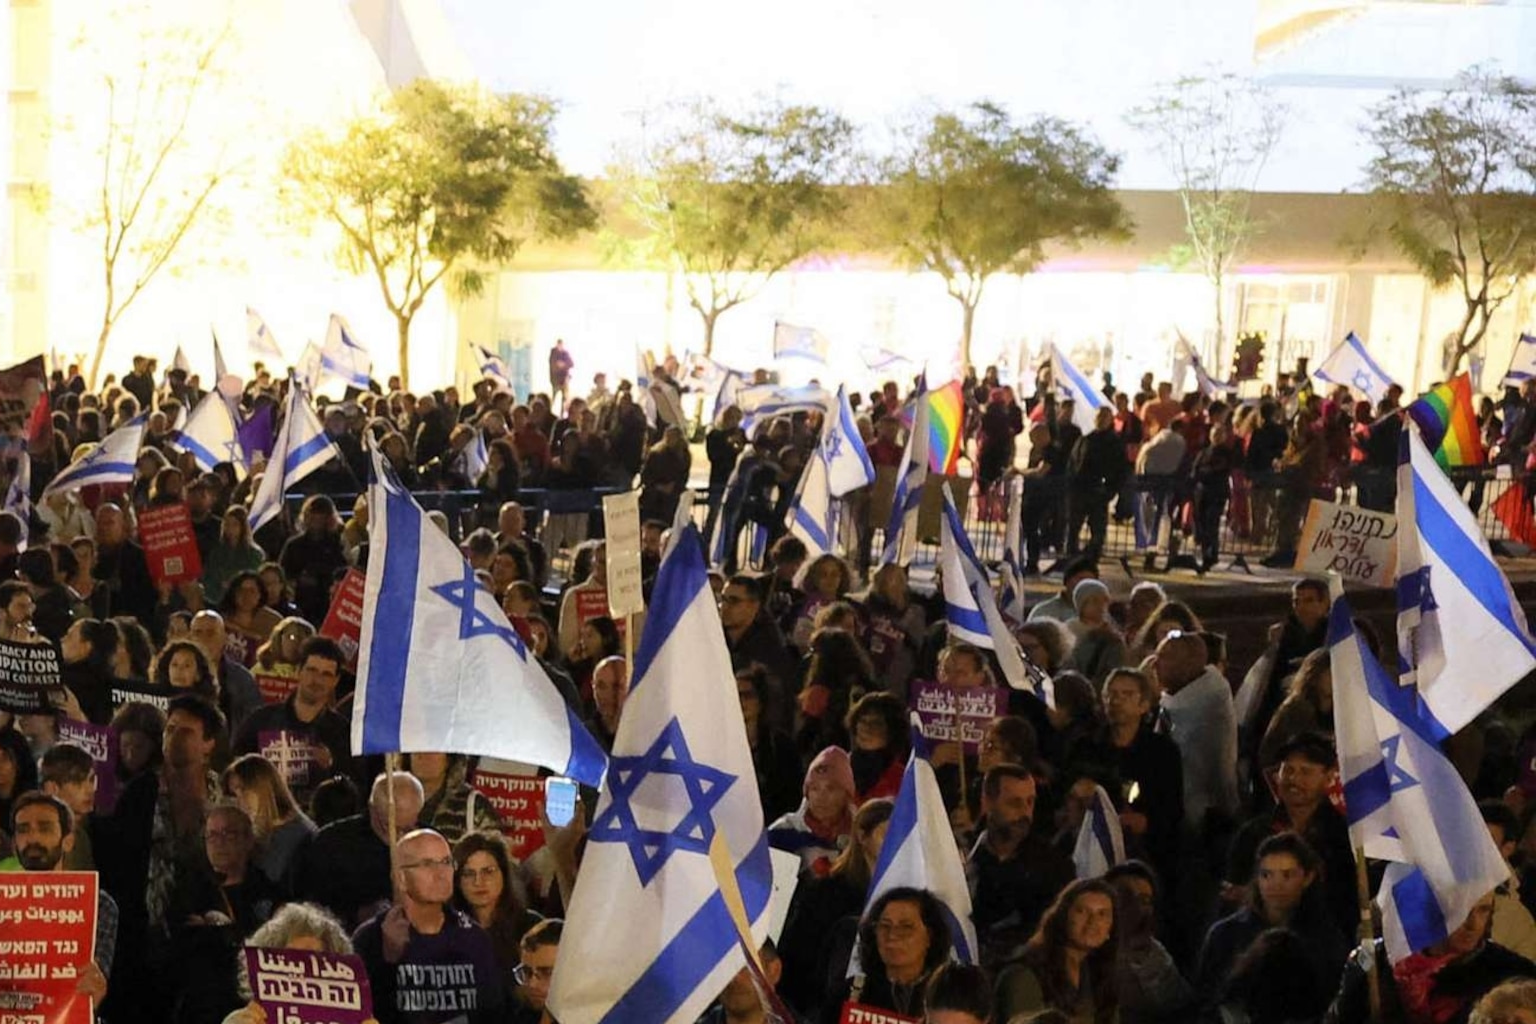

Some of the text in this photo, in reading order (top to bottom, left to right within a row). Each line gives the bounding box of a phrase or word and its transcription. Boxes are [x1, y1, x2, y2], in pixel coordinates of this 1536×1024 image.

[1332, 509, 1399, 540] נתניהו
[29, 648, 57, 661] AND
[12, 671, 62, 685] COEXIST
[475, 775, 545, 793] דמוקרטיה
[31, 884, 86, 899] יהודים
[52, 940, 79, 954] נגד
[50, 962, 77, 979] ضد
[257, 948, 356, 981] هذا بيتنا
[396, 963, 476, 988] דמוקרטיה
[263, 977, 355, 1004] זה הבית
